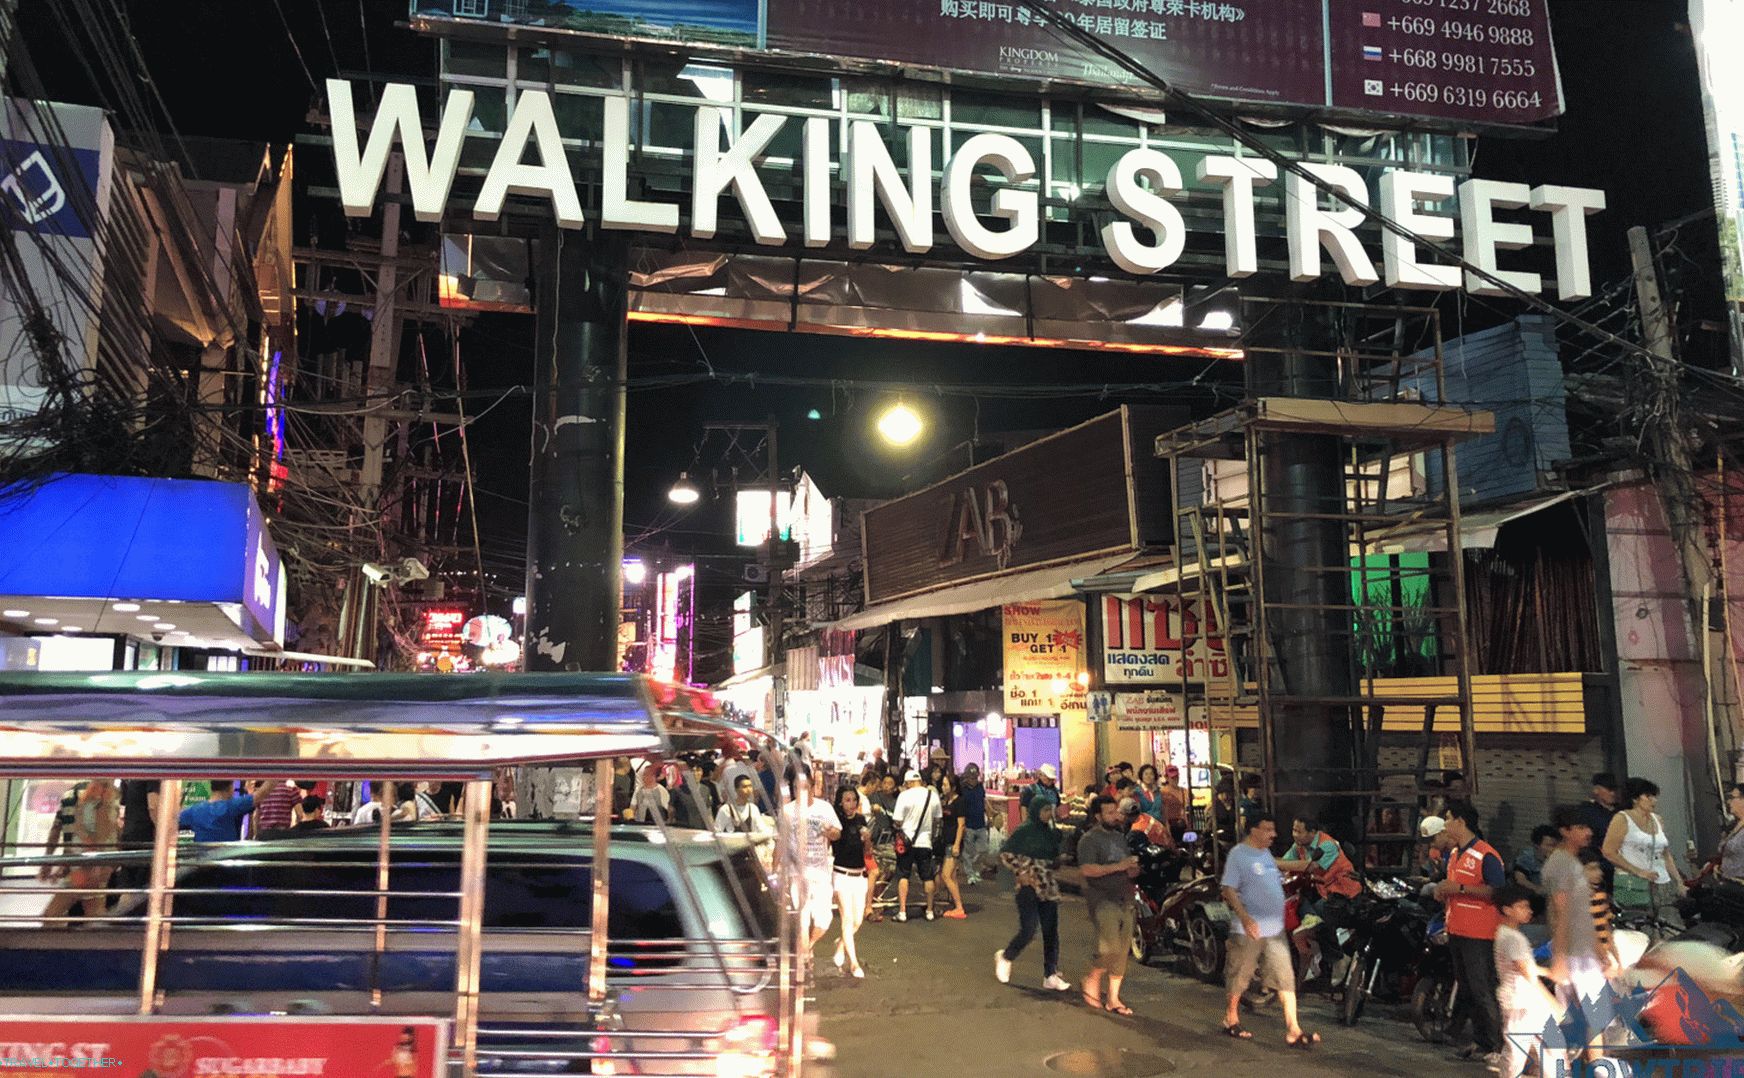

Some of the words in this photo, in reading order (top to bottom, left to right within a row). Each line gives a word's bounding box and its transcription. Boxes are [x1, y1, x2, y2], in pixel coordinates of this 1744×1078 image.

[1387, 15, 1436, 36] +669
[1441, 20, 1485, 42] 4946
[1488, 25, 1534, 46] 9888
[999, 46, 1059, 62] KINGDOM
[1389, 48, 1437, 69] +668
[1442, 52, 1485, 74] 9981
[1490, 57, 1536, 77] 7555
[1390, 82, 1439, 103] +669
[1443, 86, 1487, 107] 6319
[1492, 90, 1542, 109] 6664
[326, 78, 1039, 260] WALKING
[1101, 147, 1606, 302] STREET
[1004, 606, 1041, 616] SHOW
[1011, 633, 1038, 643] BUY
[1046, 633, 1052, 643] 1
[1030, 644, 1055, 654] GET
[1061, 645, 1067, 653] 1
